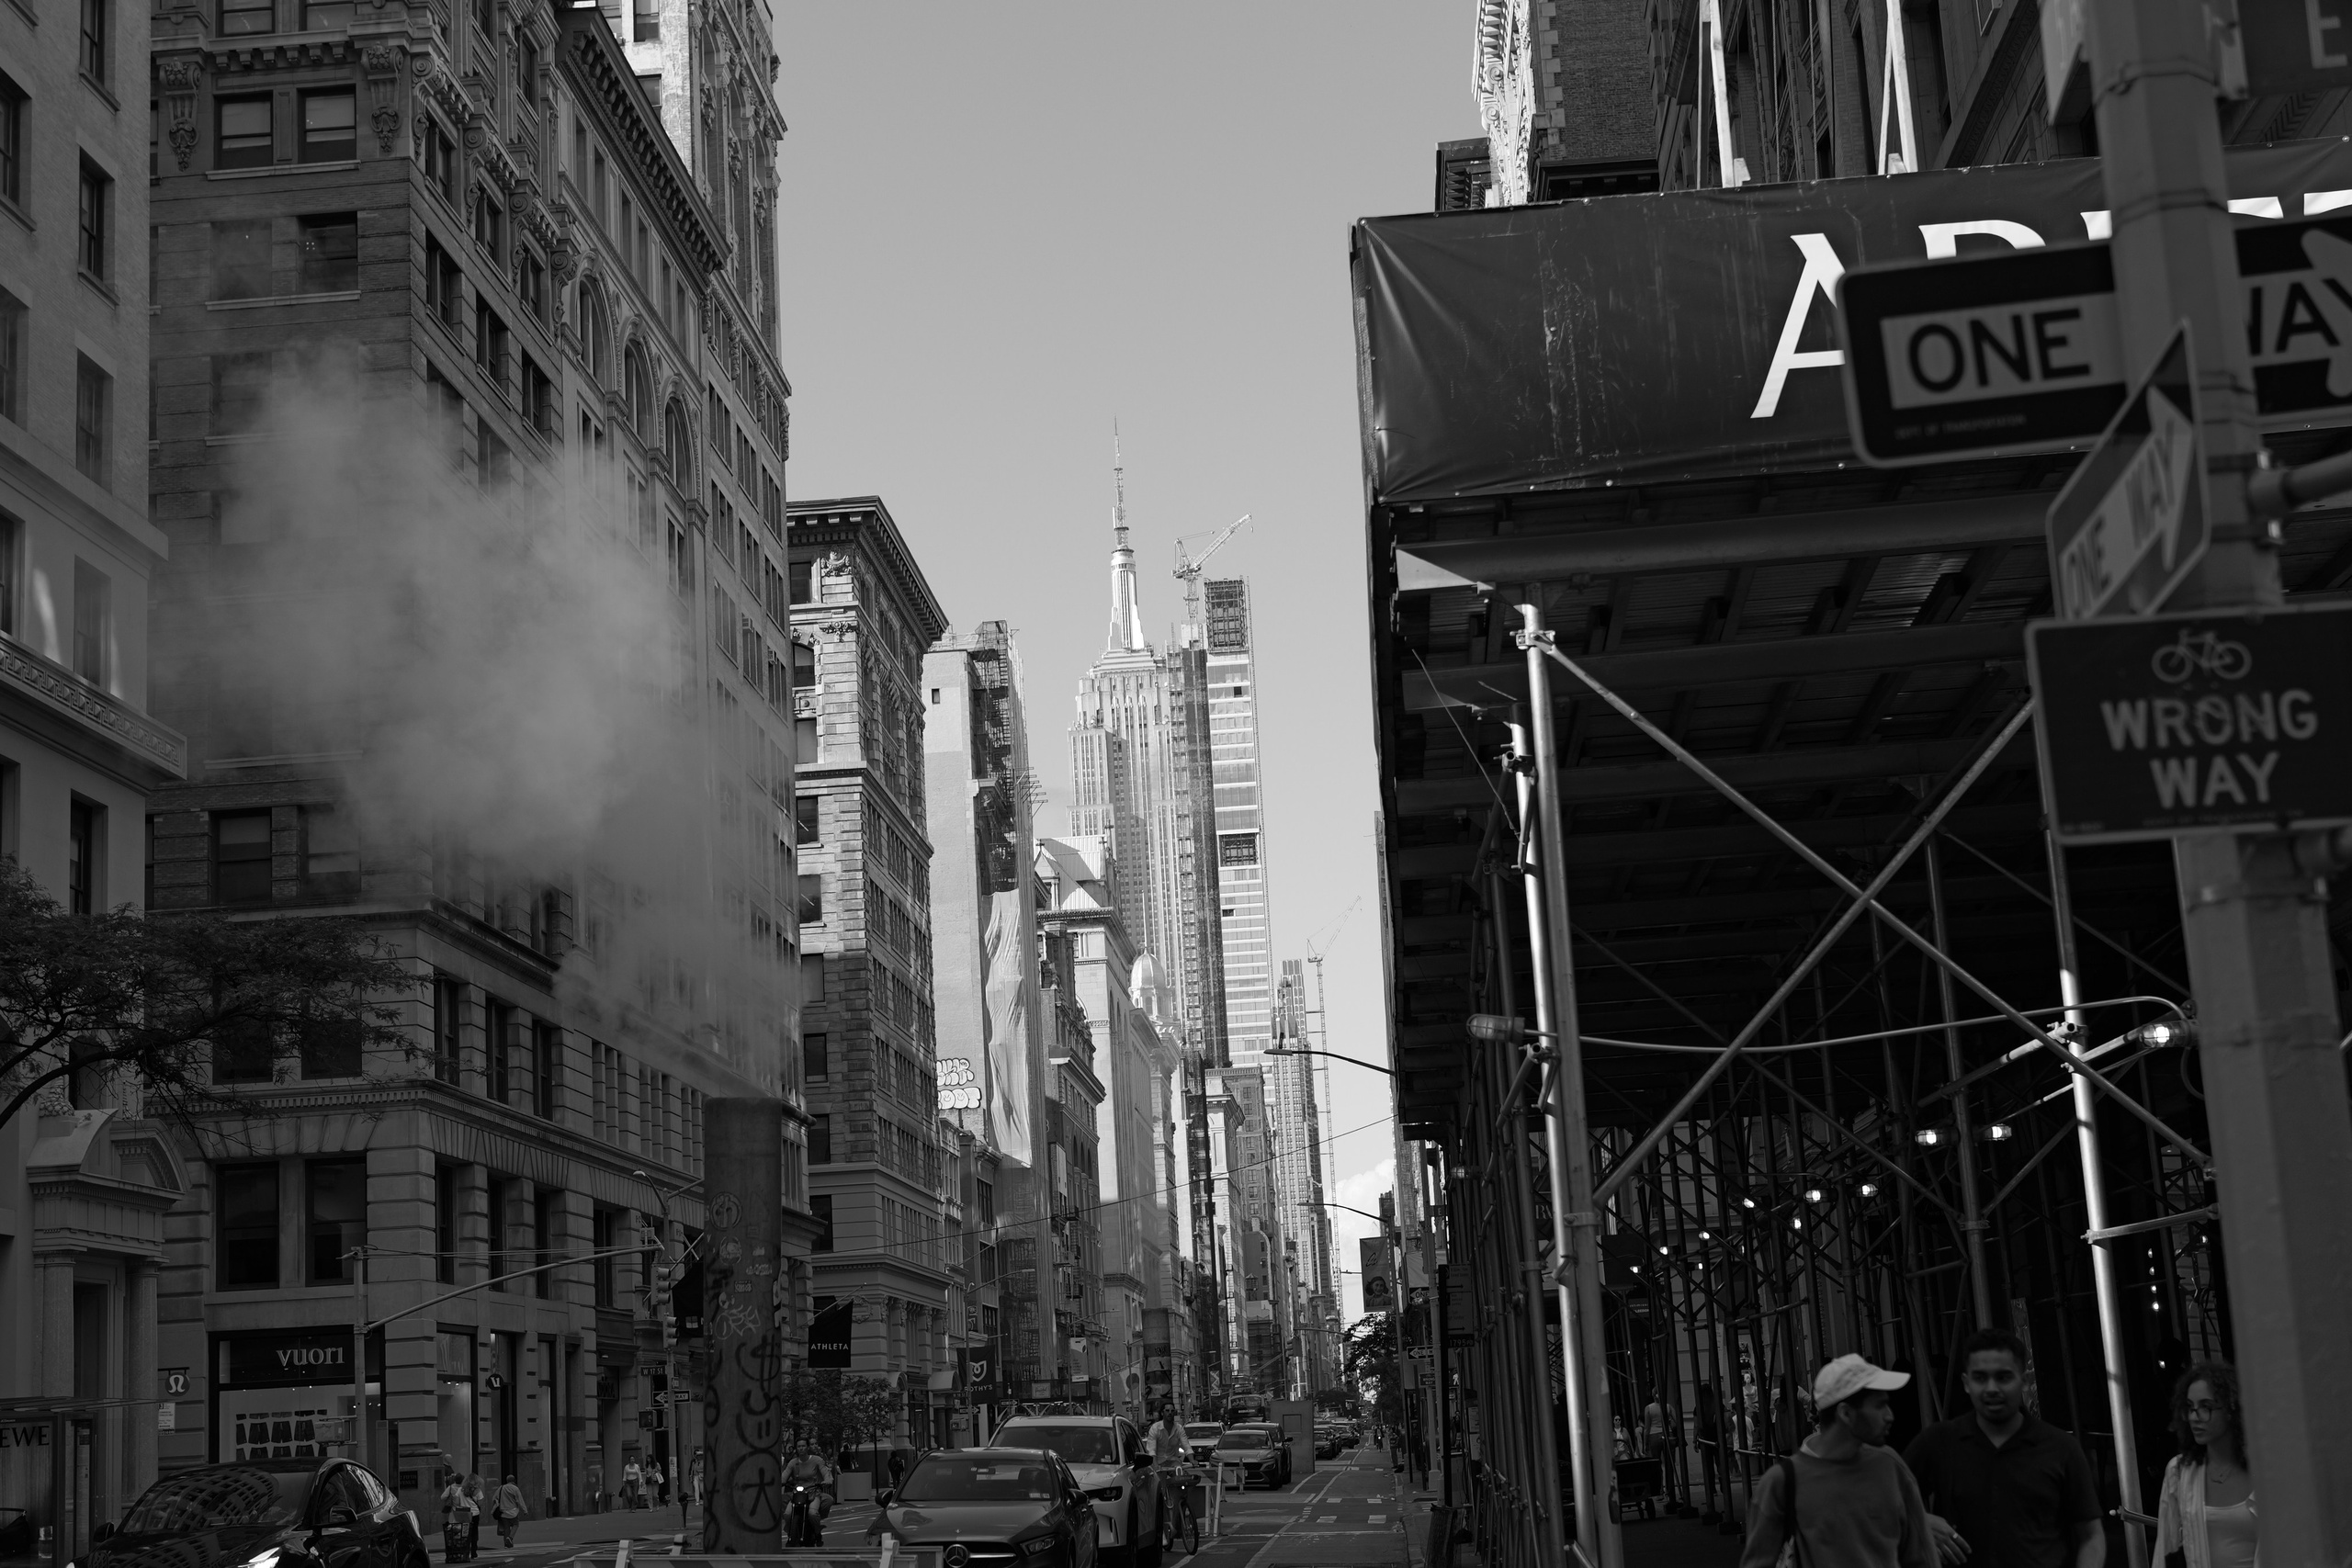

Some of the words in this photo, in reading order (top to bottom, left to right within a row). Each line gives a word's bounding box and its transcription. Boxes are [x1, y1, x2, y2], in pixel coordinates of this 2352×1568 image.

[1908, 308, 2091, 392] ONE
[2099, 688, 2319, 751] WRONG
[2149, 750, 2280, 809] WAY
